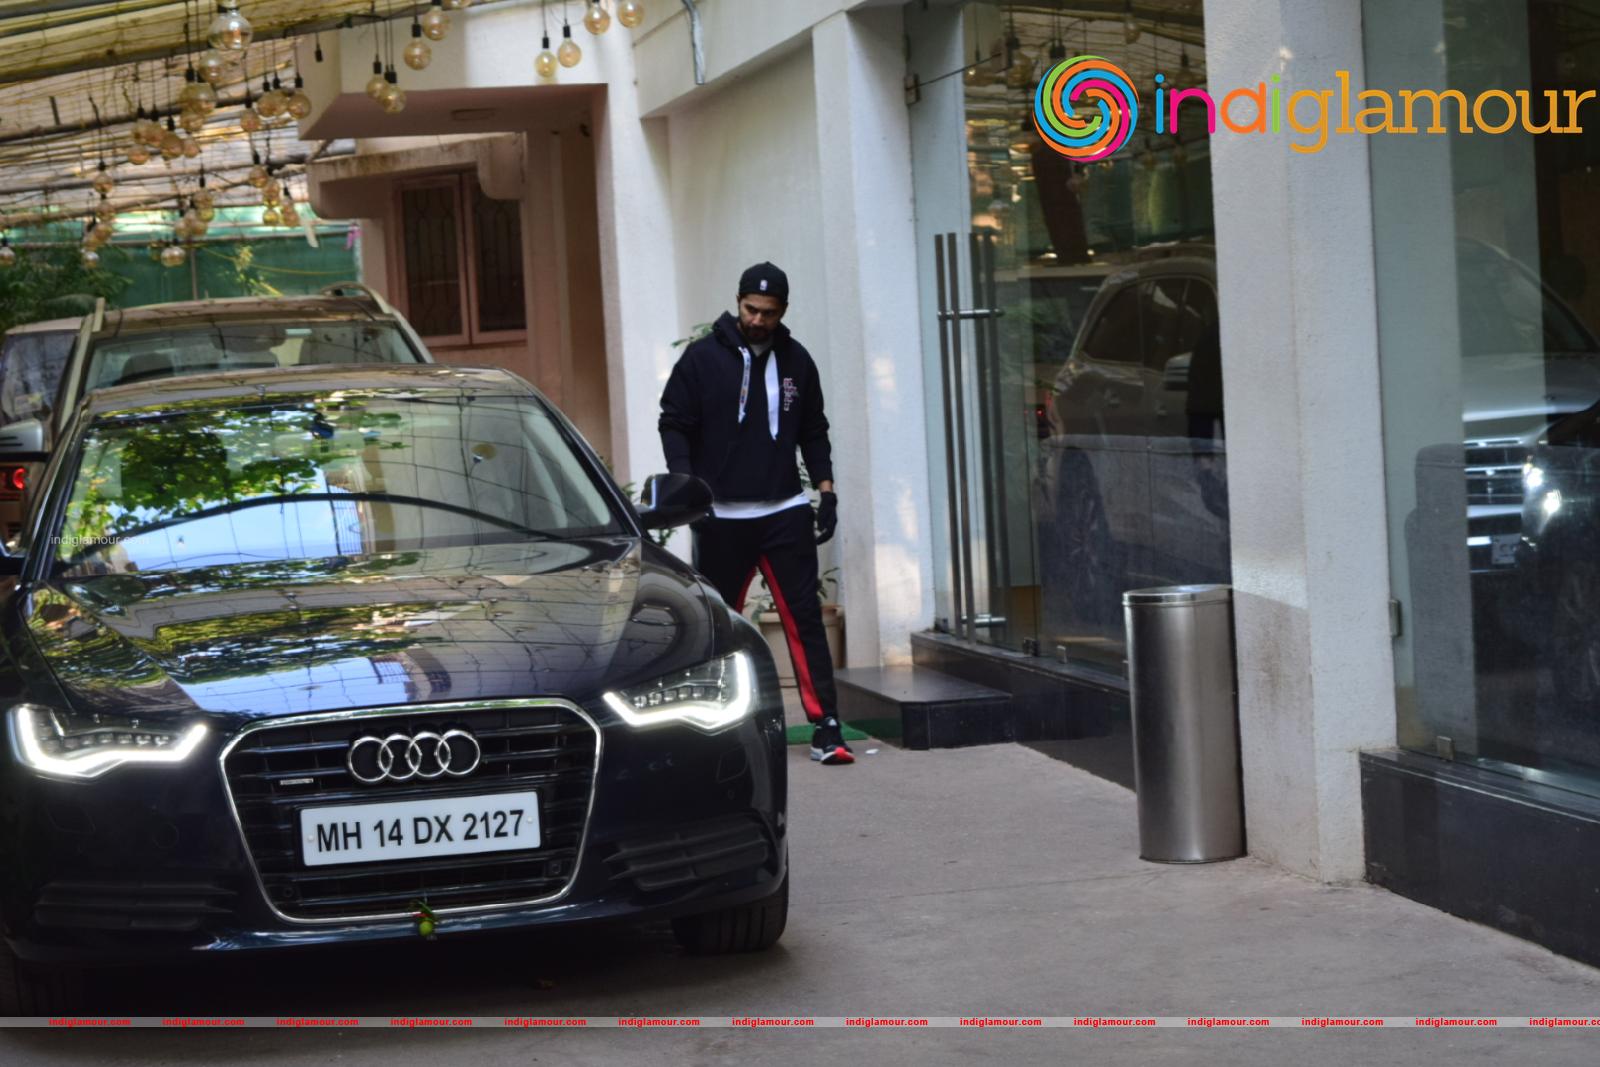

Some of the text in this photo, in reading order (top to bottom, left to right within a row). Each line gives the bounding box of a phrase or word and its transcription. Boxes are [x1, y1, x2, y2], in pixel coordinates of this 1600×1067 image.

[317, 809, 524, 852] MH 14 DX 2127
